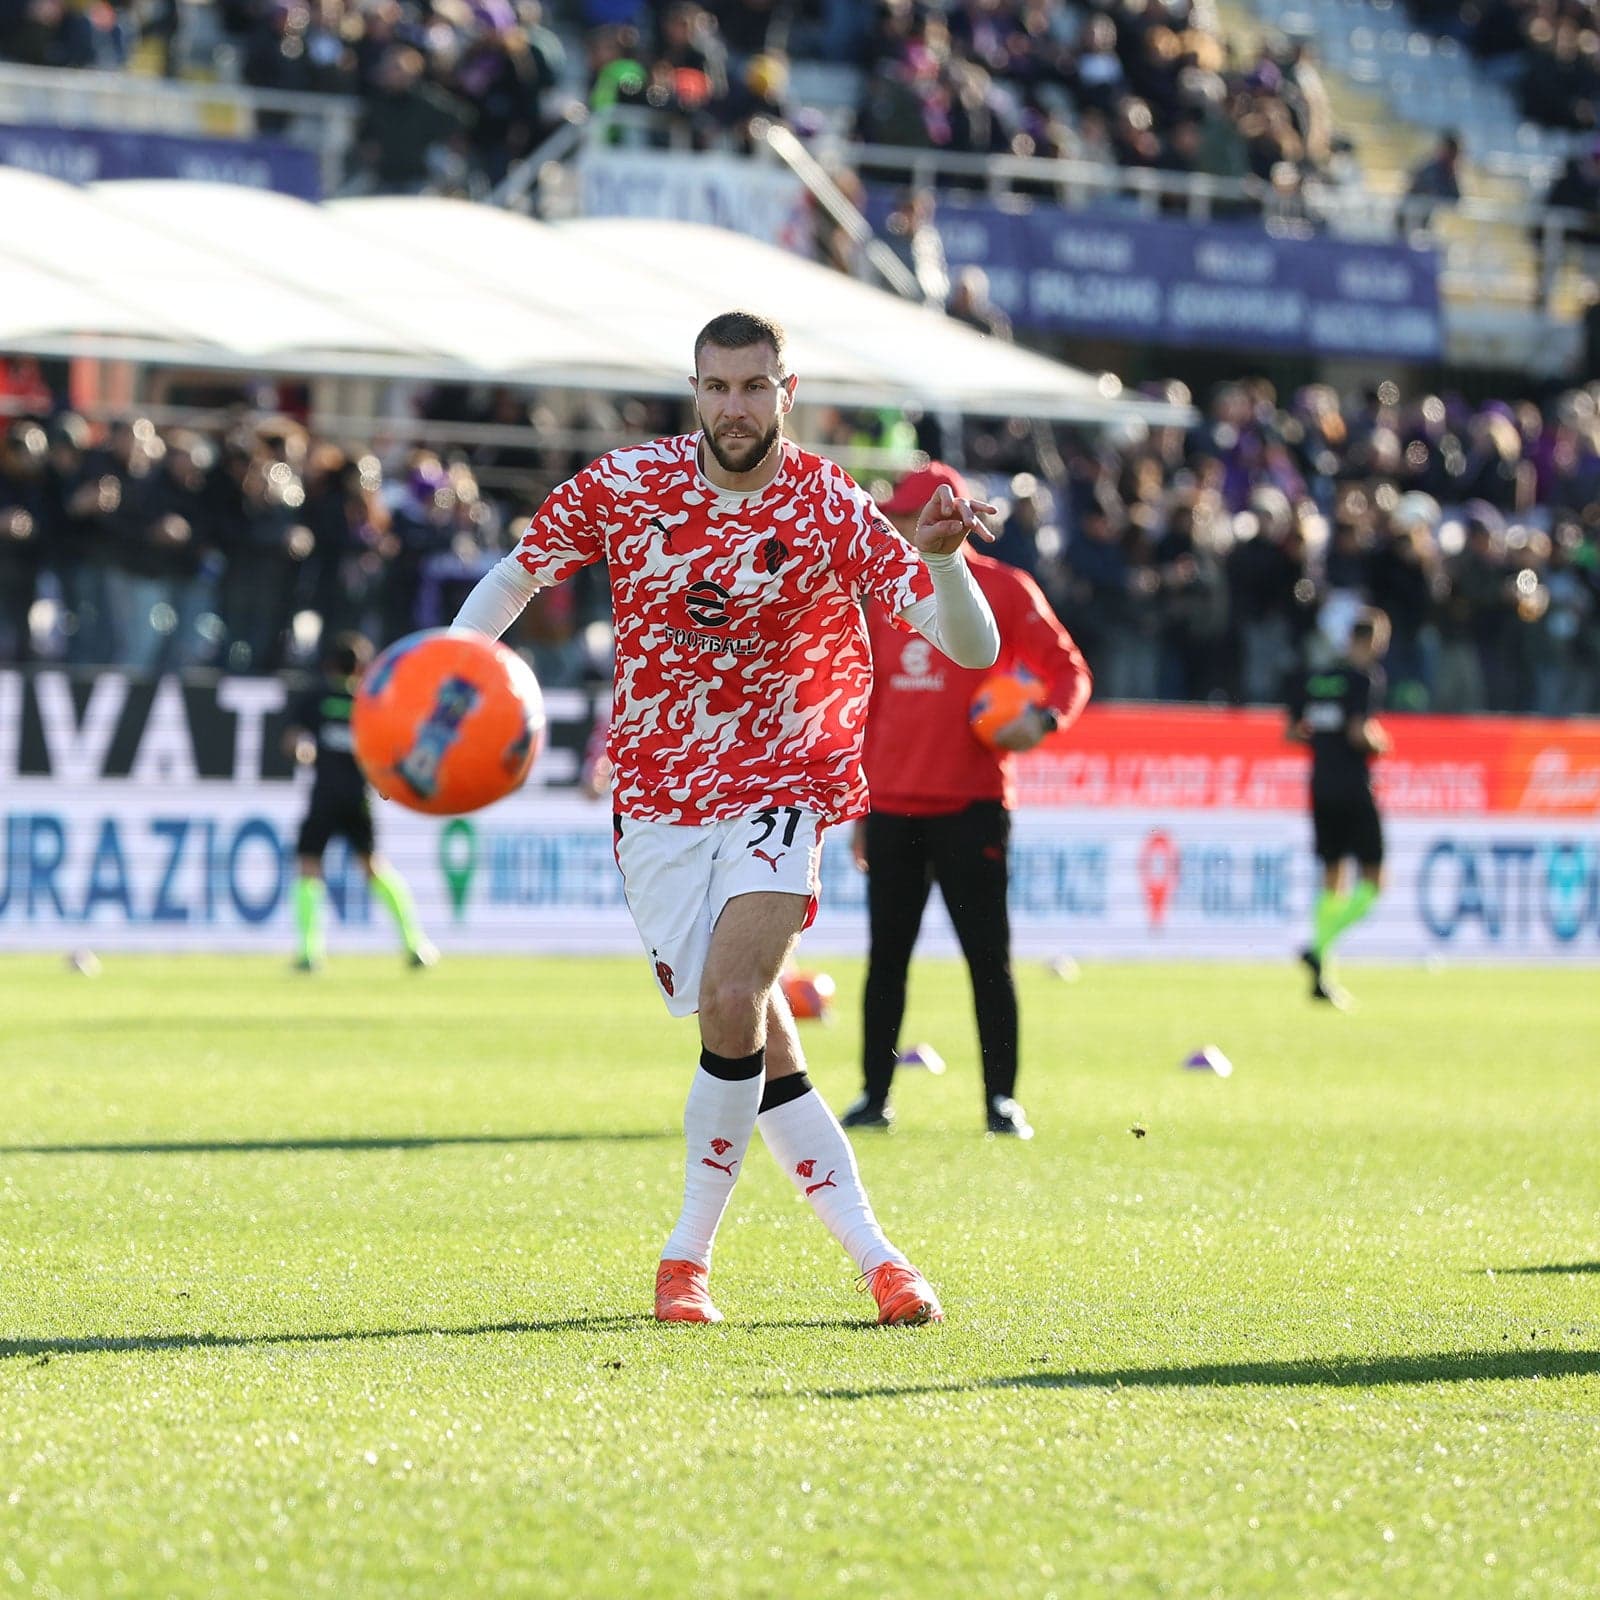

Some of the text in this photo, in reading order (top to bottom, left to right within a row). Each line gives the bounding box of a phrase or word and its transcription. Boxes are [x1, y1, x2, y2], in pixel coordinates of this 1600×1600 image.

[664, 625, 757, 655] FOOTBALL
[0, 670, 288, 784] IVAT
[746, 806, 802, 849] 31
[1416, 838, 1600, 942] CATTO
